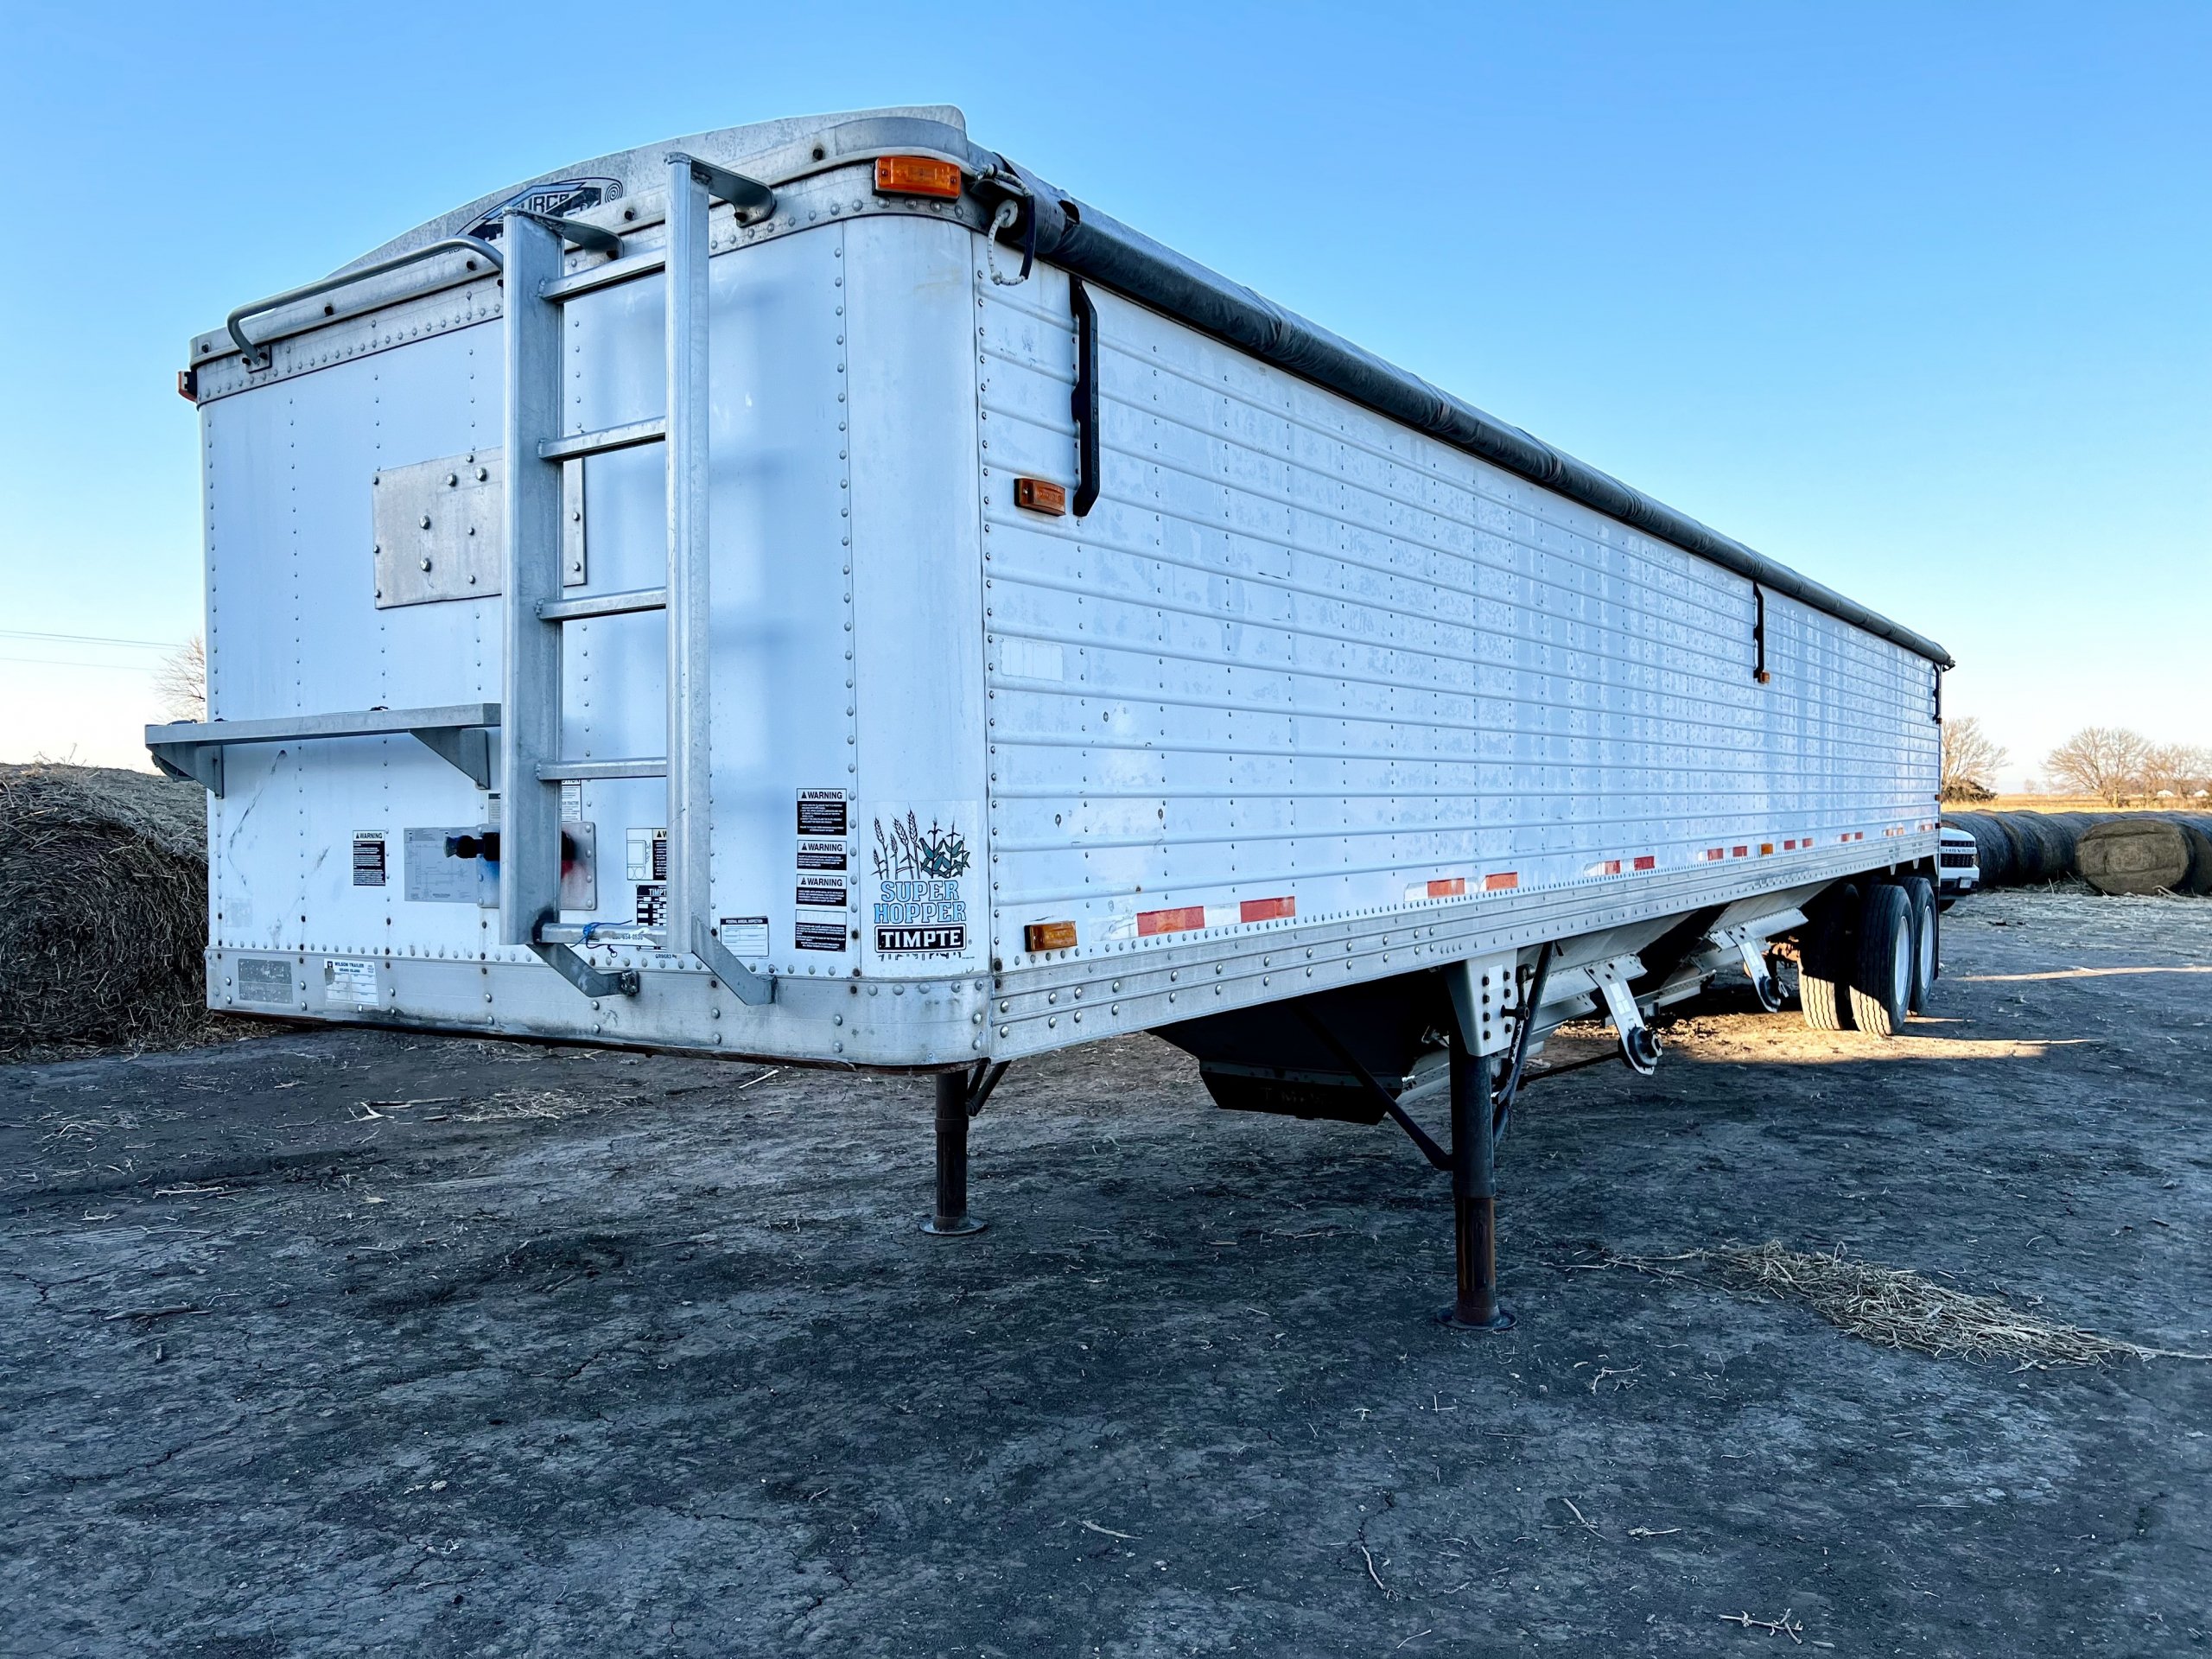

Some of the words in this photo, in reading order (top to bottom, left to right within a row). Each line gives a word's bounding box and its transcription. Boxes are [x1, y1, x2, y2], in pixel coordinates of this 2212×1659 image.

[808, 842, 842, 852] WARNING
[807, 877, 842, 887] WARNING
[880, 880, 959, 902] SUPER
[874, 901, 967, 924] HOPPER
[880, 929, 961, 948] TIMPTE
